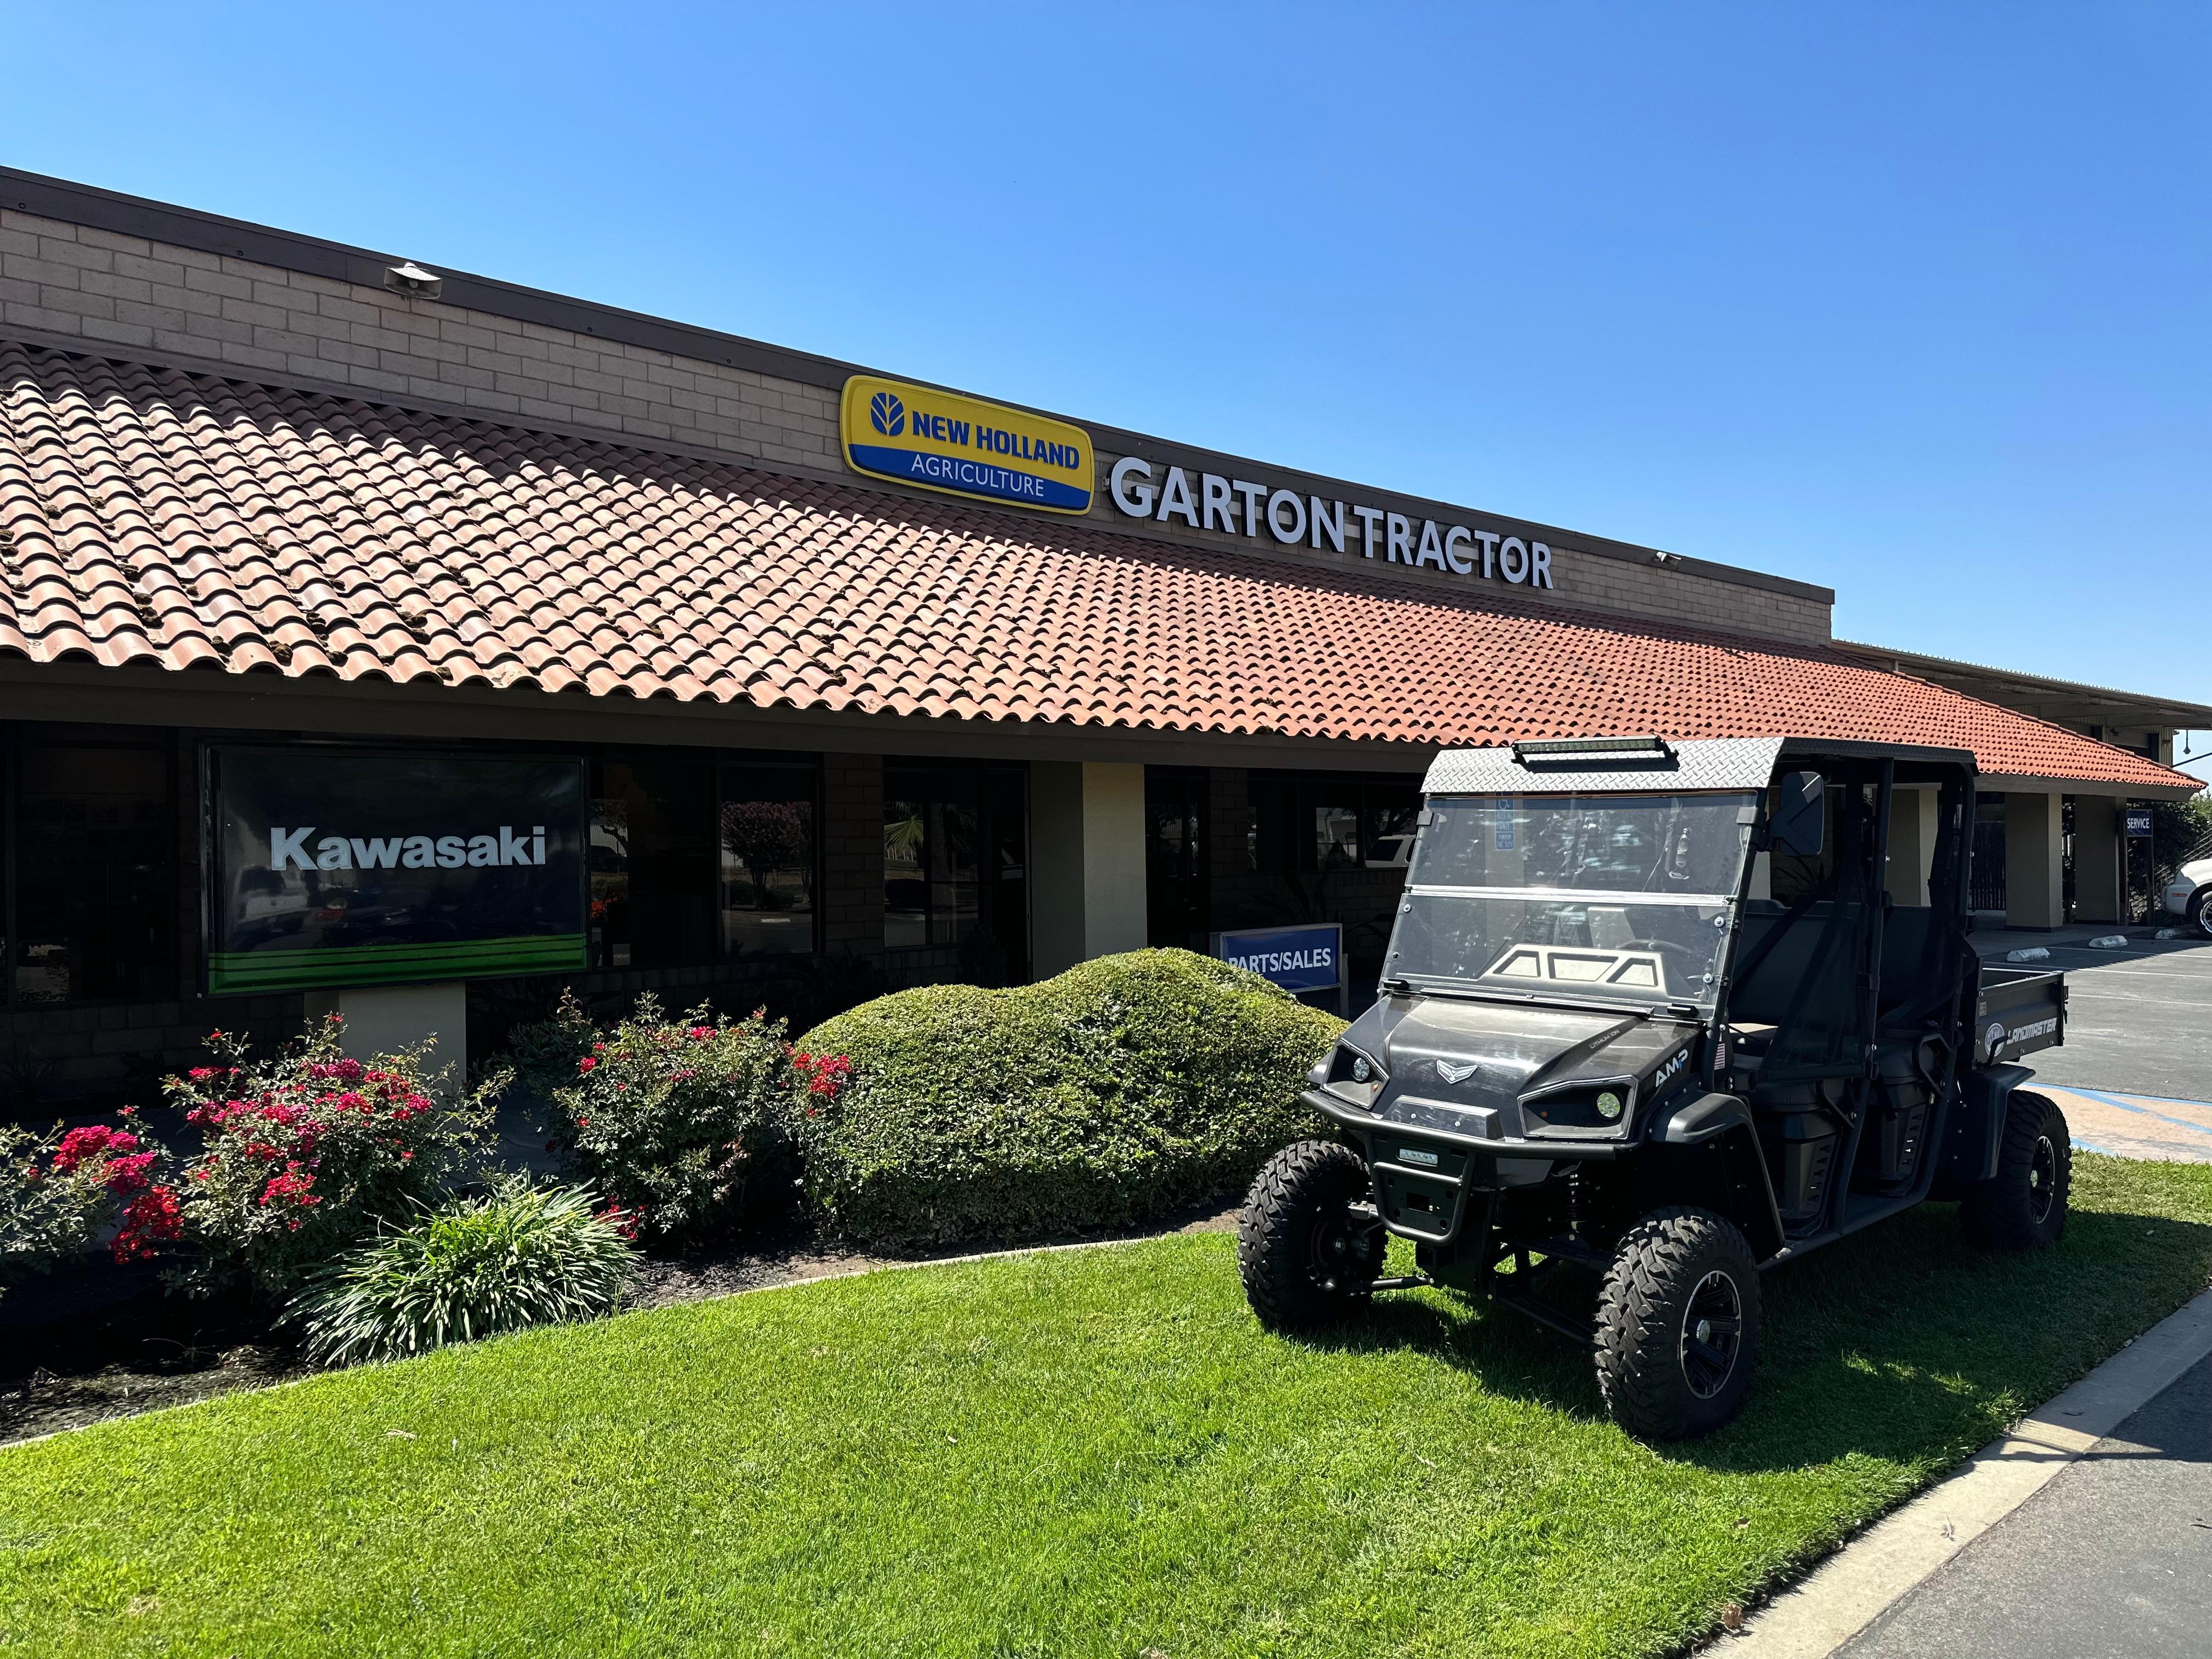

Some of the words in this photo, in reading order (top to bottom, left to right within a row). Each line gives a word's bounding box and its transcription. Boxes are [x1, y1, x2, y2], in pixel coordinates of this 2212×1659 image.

[912, 411, 969, 445] NEW
[976, 425, 1080, 470] HOLLAND
[911, 454, 1044, 496] AGRICULTURE
[1108, 456, 1345, 552] GARTON
[1351, 505, 1553, 589] TRACTOR
[2127, 817, 2149, 829] SERVICE
[271, 826, 545, 870] Kawasaki
[2006, 1017, 2057, 1045] LANDMASTER
[1656, 1049, 1688, 1087] AMP
